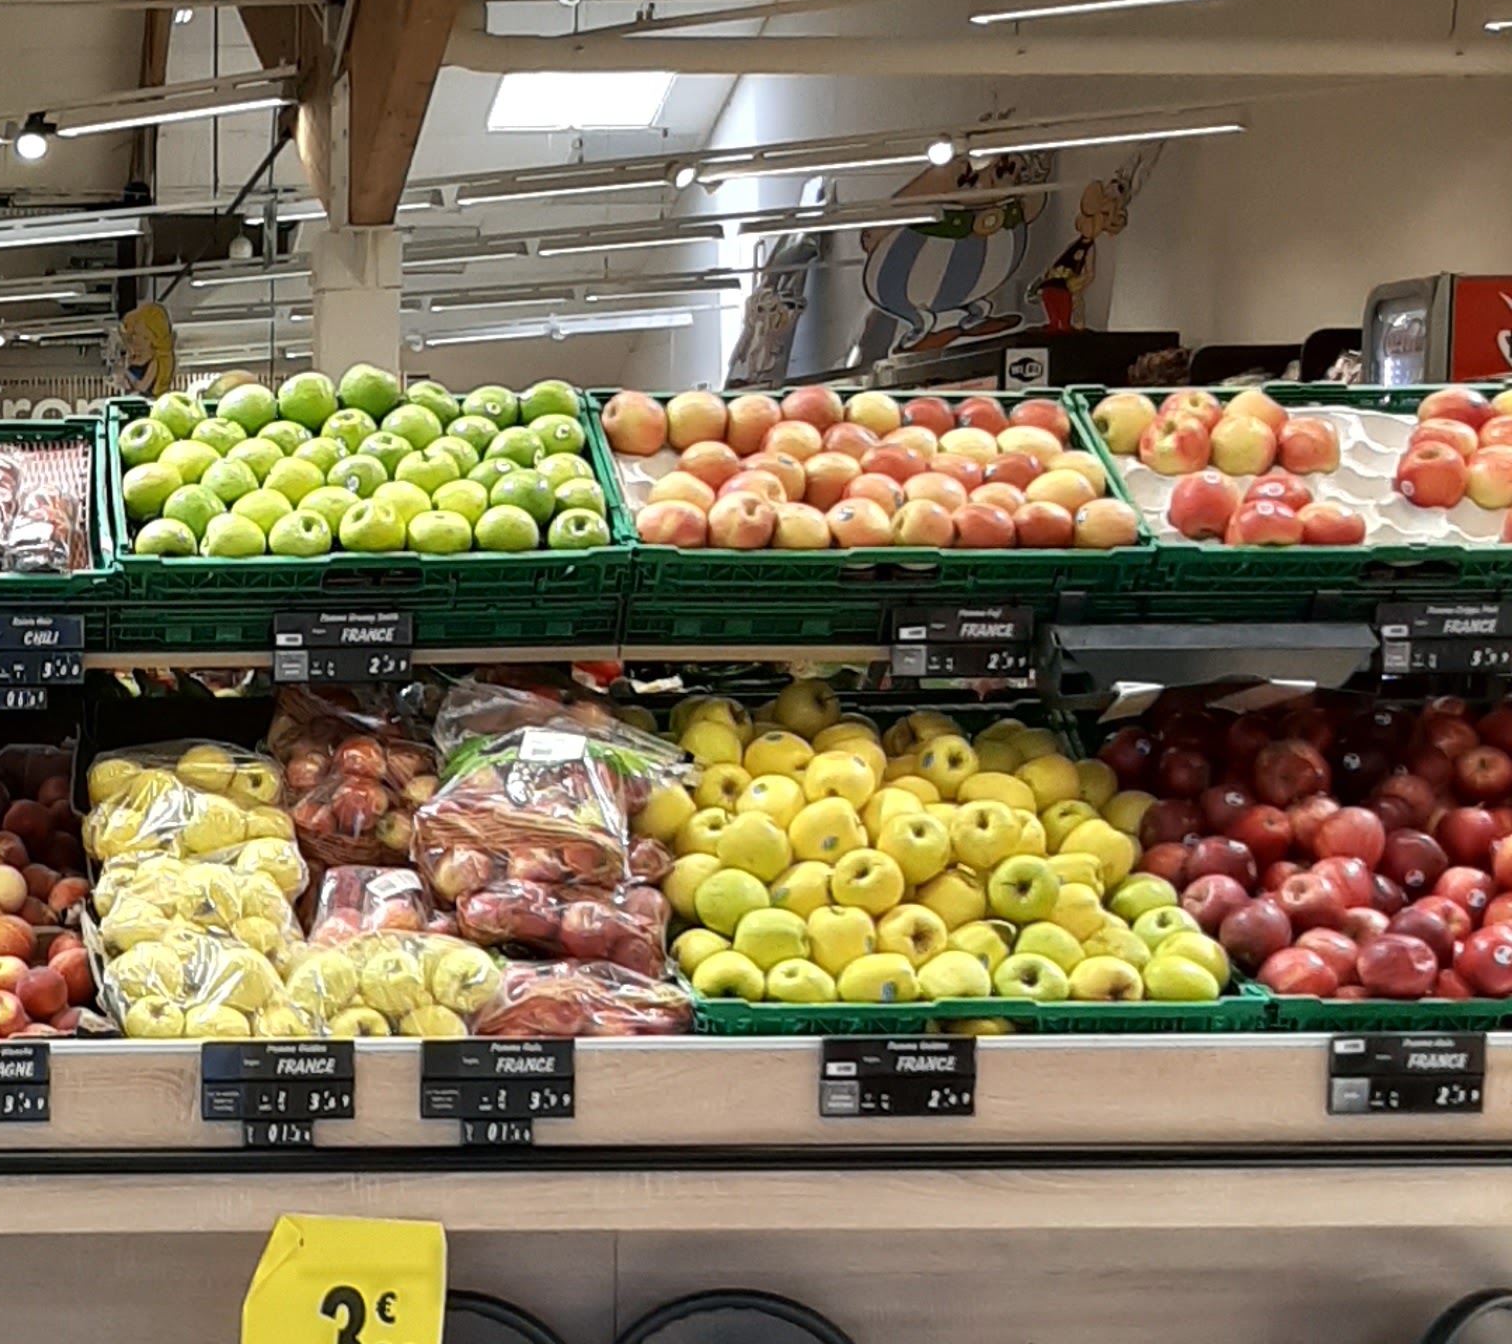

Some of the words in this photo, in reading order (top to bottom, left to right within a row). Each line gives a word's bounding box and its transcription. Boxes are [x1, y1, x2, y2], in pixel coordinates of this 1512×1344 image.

[960, 623, 1014, 637] FRANCE
[1443, 618, 1498, 634] FRANCE
[340, 627, 396, 642] FRANCE
[276, 1057, 336, 1074] FRANCE
[495, 1056, 556, 1073] FRANCE
[895, 1055, 957, 1072] FRANCE
[1407, 1053, 1468, 1069] FRANCE
